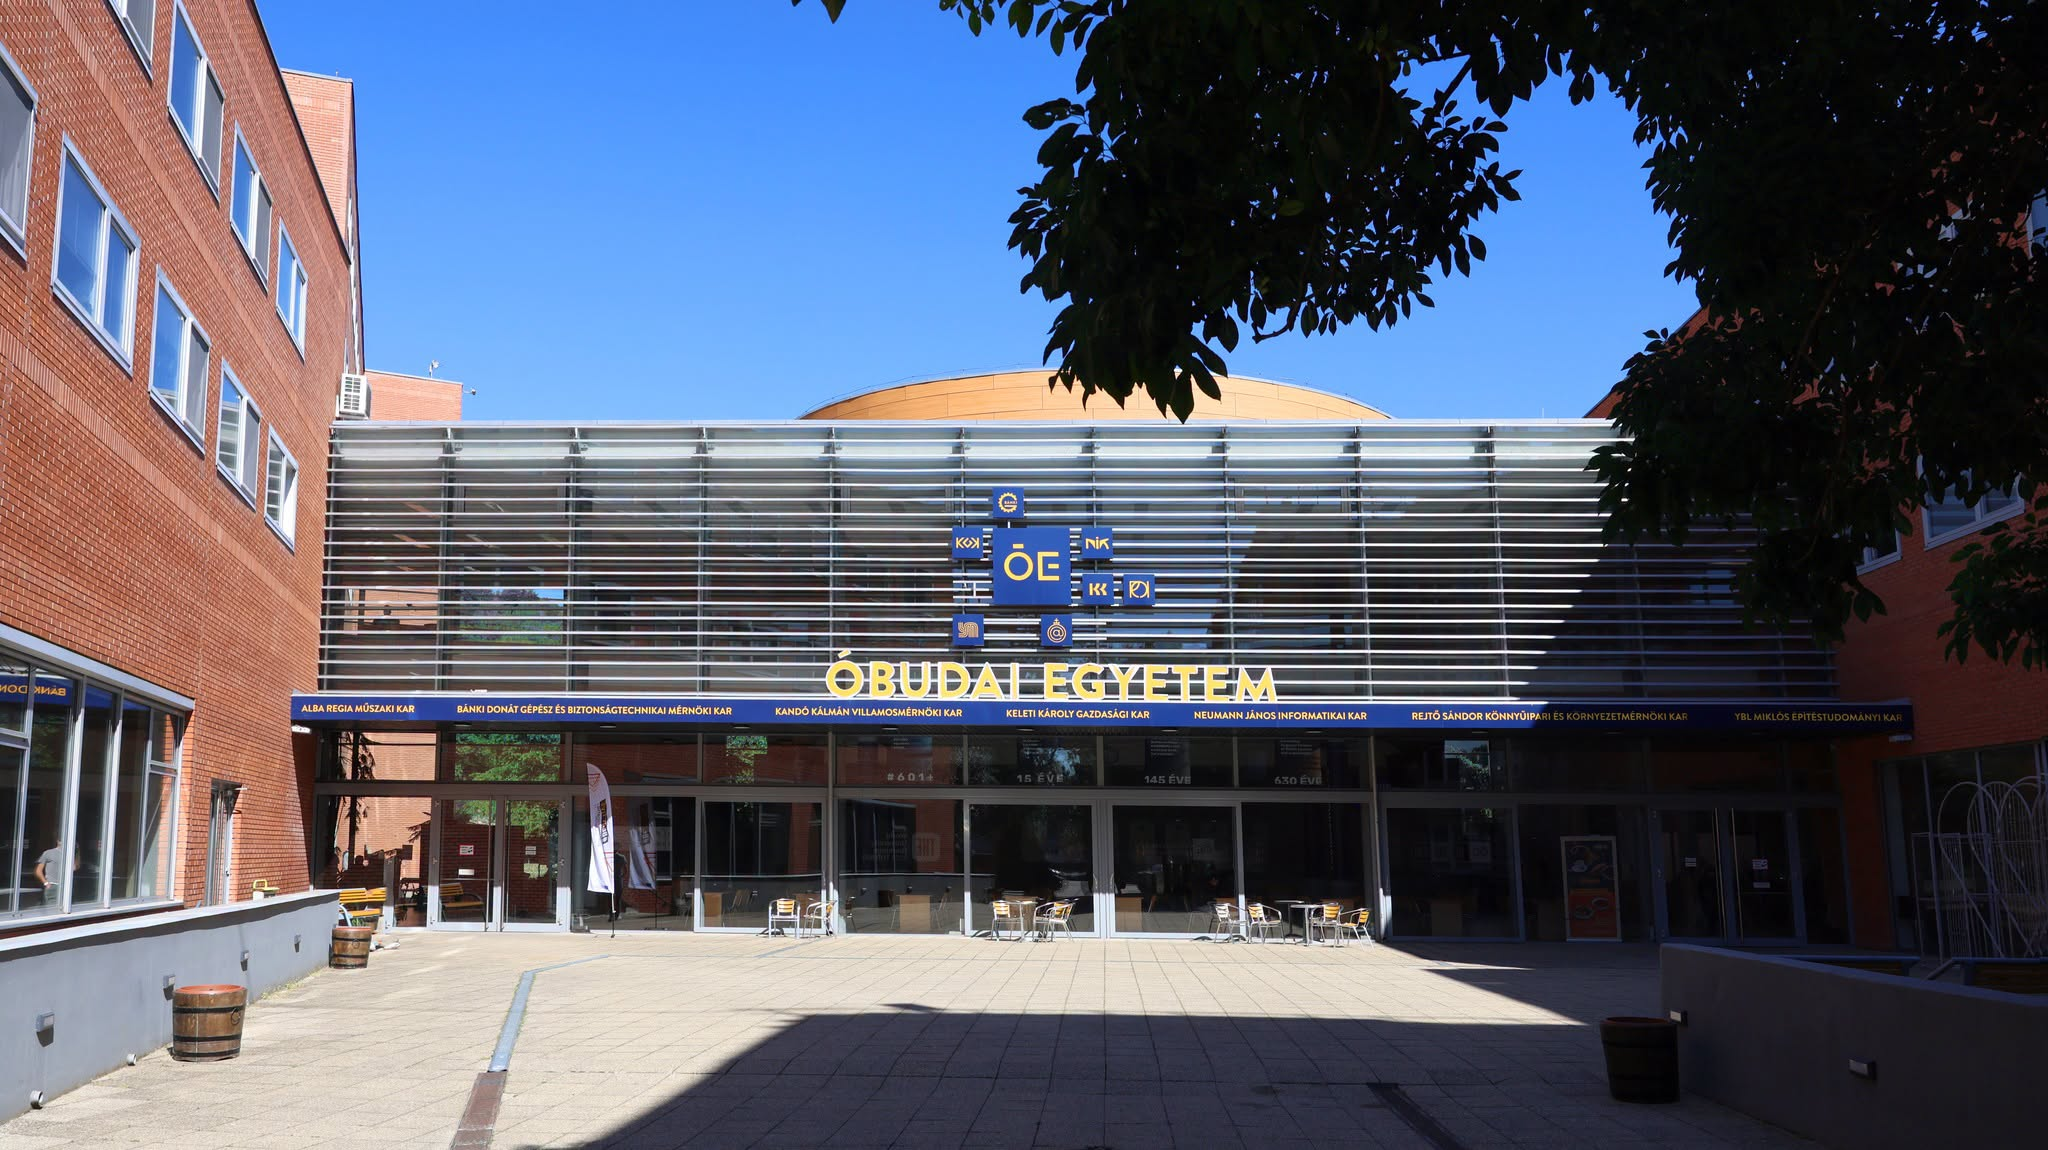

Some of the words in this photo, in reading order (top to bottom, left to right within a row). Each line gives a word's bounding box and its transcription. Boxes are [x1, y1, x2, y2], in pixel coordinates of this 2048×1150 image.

[826, 649, 1019, 700] ÓBUDAI
[1044, 662, 1278, 702] EGYETEM
[326, 705, 353, 713] REGIA
[355, 702, 394, 713] MŰSZAKI
[396, 705, 415, 713] KAR
[457, 704, 484, 713] BÁNKI
[487, 704, 519, 713] DONÁT
[520, 704, 553, 714] GÉPÉSZ
[555, 704, 565, 714] ÉS
[568, 704, 666, 714] BIZTONSÁGTECHNIKAI
[668, 705, 711, 715] MÉRNÖKI
[714, 707, 732, 715] KAR
[775, 706, 809, 715] KANDÓ
[812, 706, 850, 716] KÁLMÁN
[852, 707, 941, 716] VILLAMOSMÉRNÖKI
[1006, 710, 1036, 718] KELETI
[1038, 708, 1074, 718] KÁROLY
[1076, 709, 1128, 718] GAZDASÁGI
[1194, 712, 1243, 720] NEUMANN
[1245, 710, 1276, 720] JÁNOS
[1278, 712, 1345, 720] INFORMATIKAI
[1412, 710, 1440, 720] REJTŐ
[1443, 710, 1483, 720] SÁNDOR
[1554, 711, 1564, 720] ÉS
[1754, 712, 1790, 721] MIKLÓS
